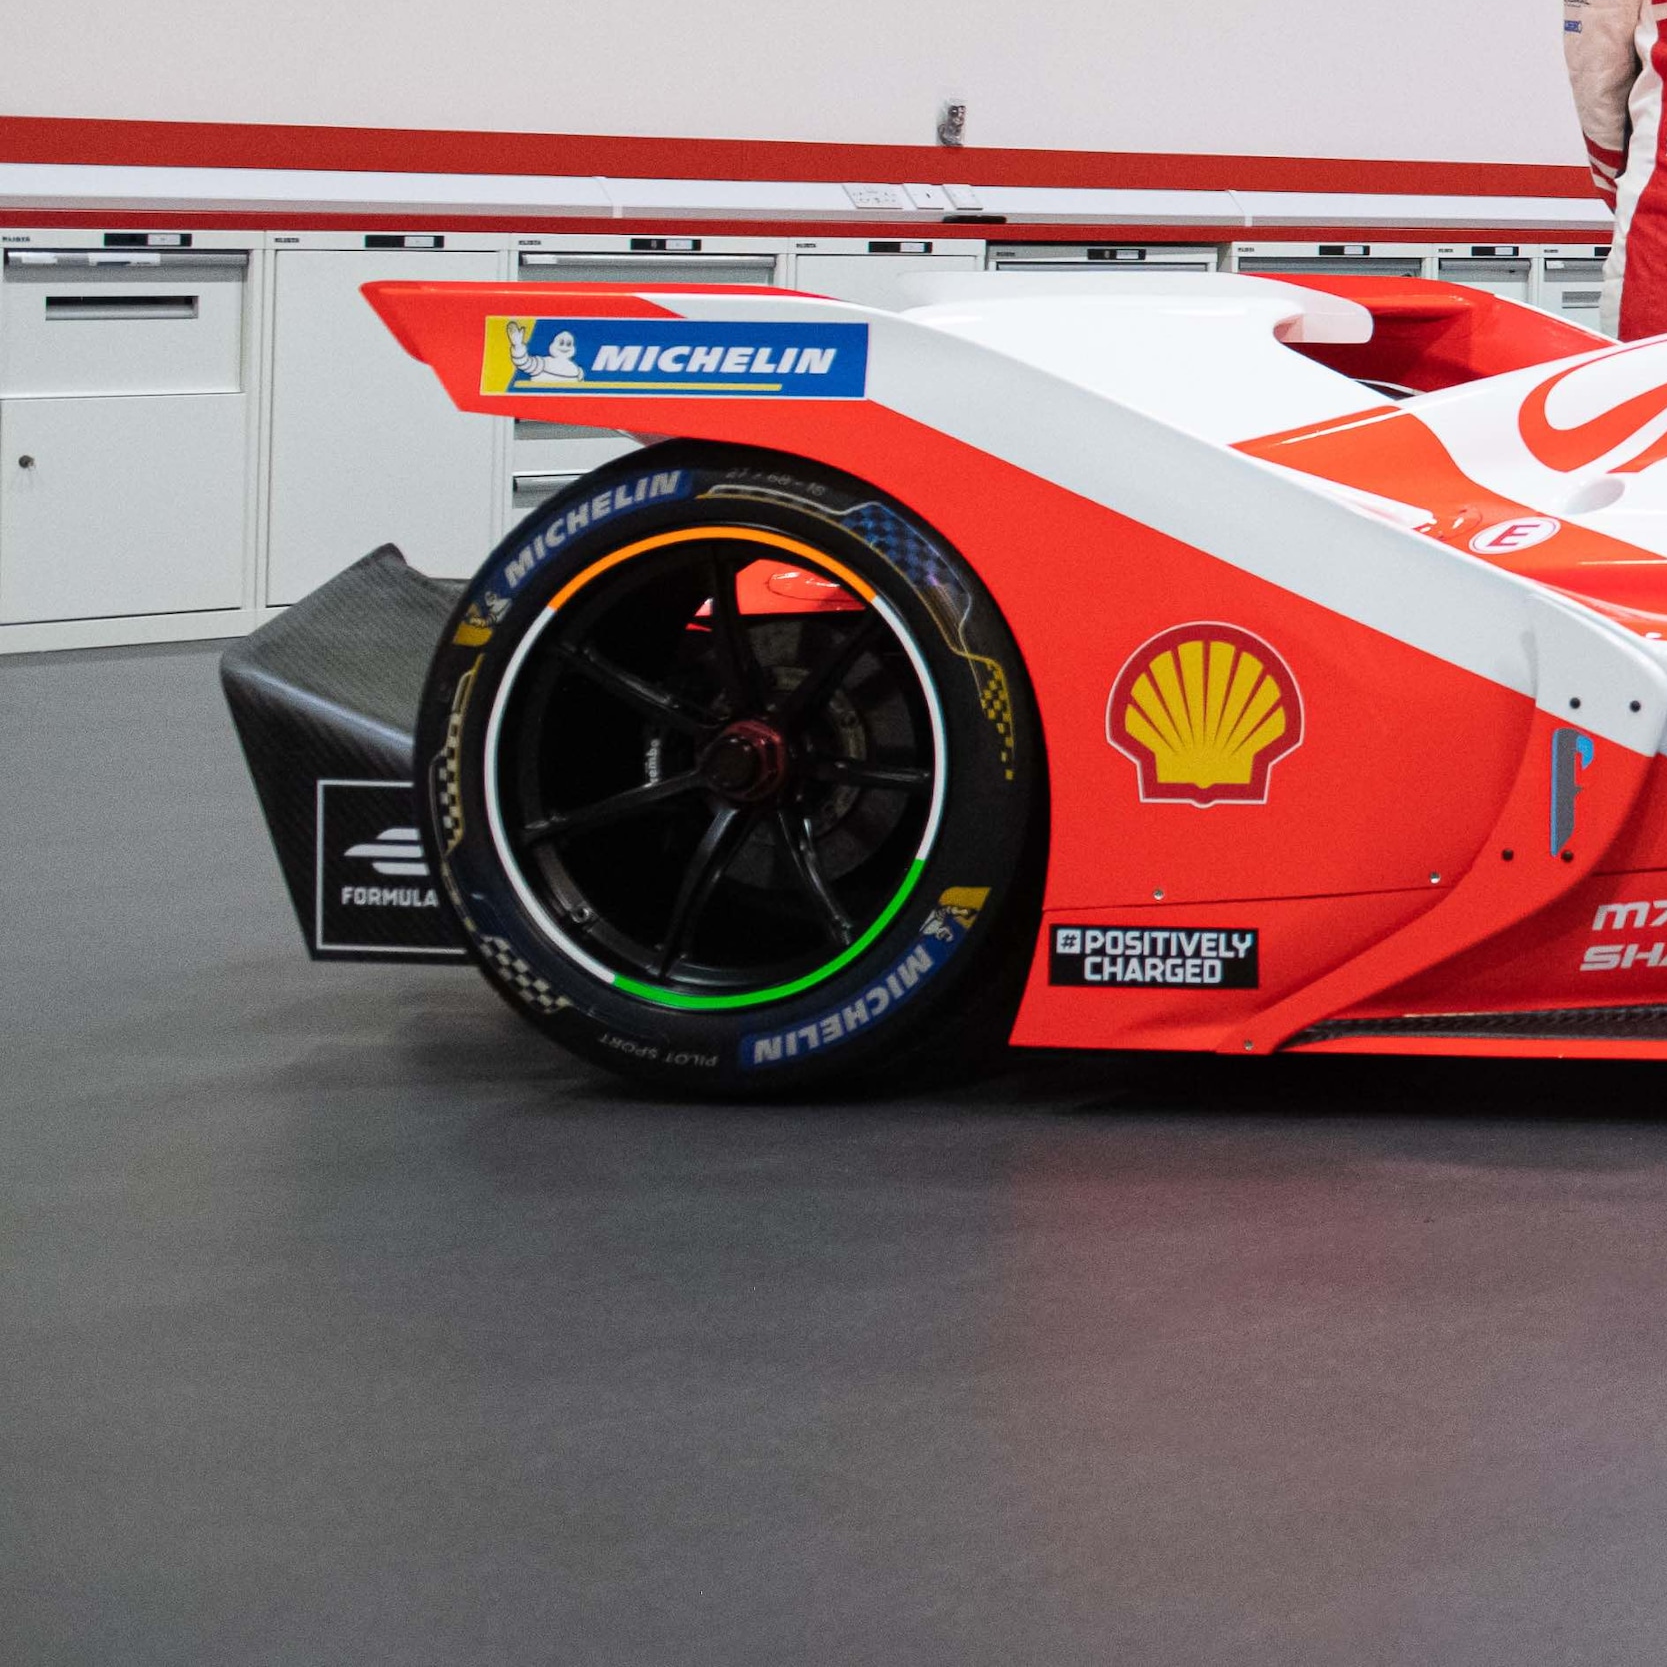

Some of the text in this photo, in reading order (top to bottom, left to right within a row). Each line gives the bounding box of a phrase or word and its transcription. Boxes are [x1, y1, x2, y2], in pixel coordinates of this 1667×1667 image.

[590, 344, 837, 377] MICHELIN
[503, 470, 683, 590] MICHELIN
[341, 886, 440, 908] FORMULA
[1083, 955, 1224, 985] CHARGED
[753, 944, 933, 1068] MICHELIN
[600, 1033, 719, 1068] PILOT SPORT
